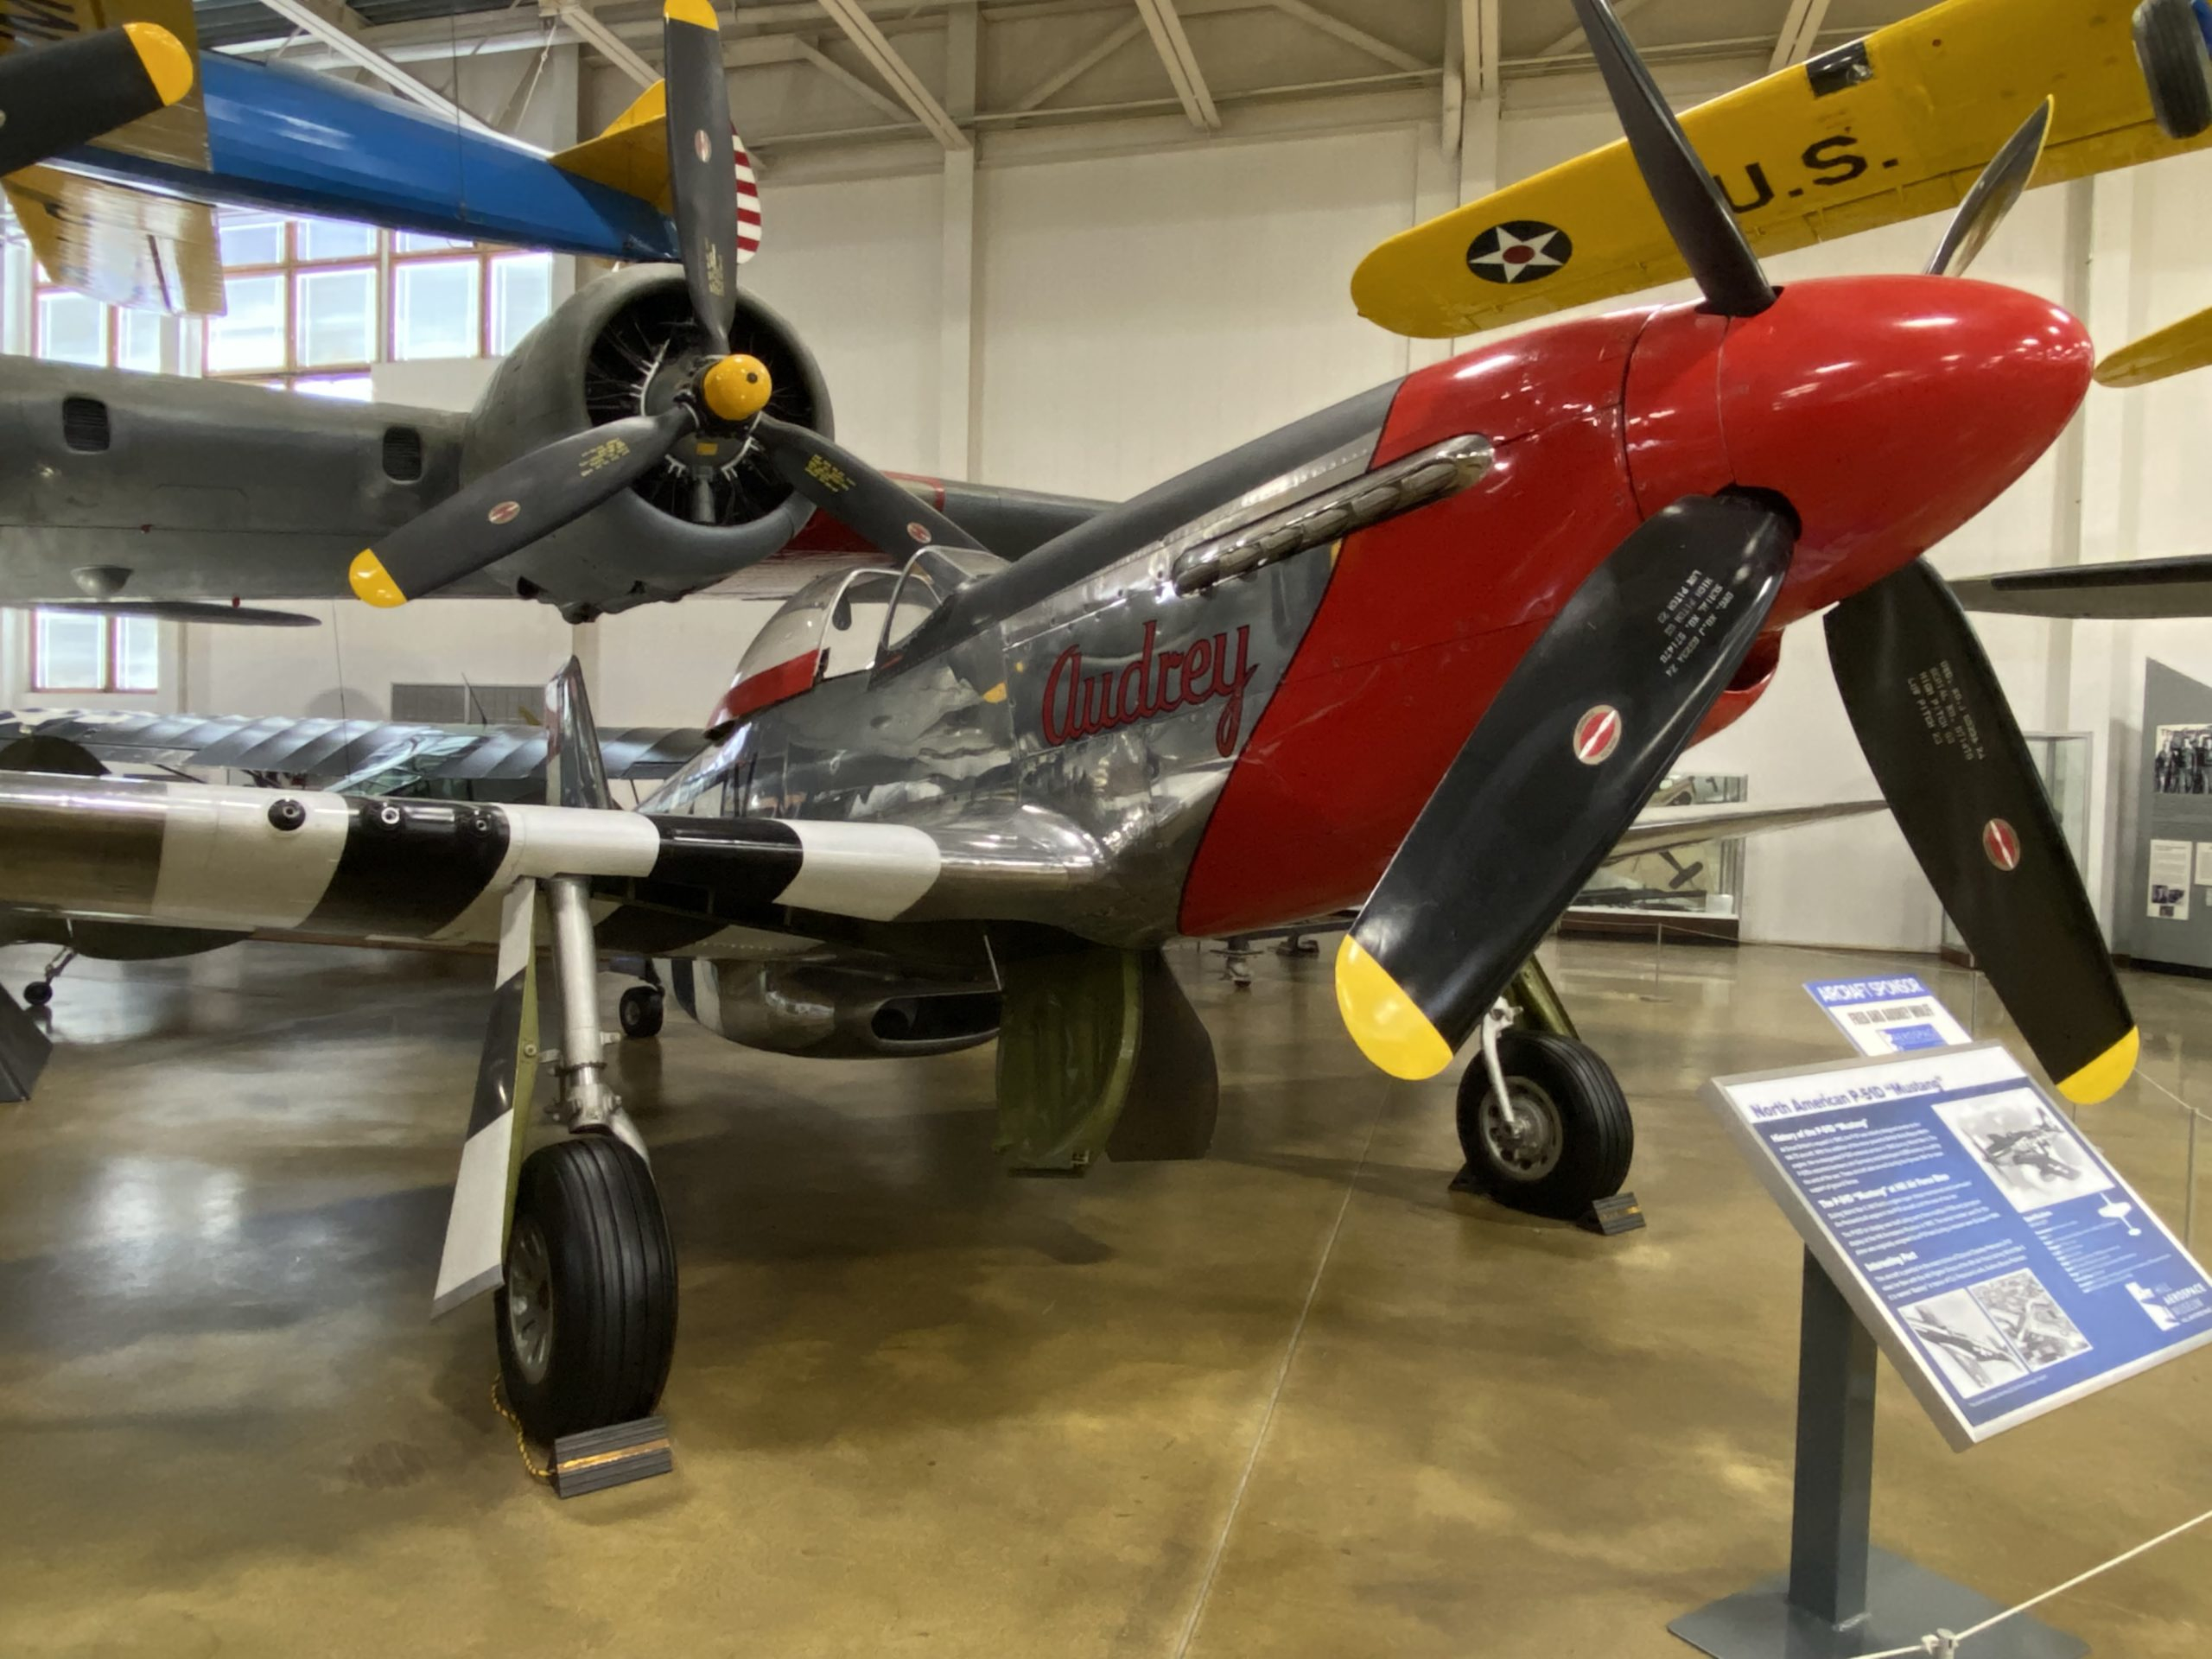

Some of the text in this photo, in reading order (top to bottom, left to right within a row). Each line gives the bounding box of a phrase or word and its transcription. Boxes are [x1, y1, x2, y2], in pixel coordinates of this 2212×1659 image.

[1713, 135, 1899, 213] U.S.
[1667, 586, 1689, 611] PITCH
[1694, 577, 1713, 598] HIGH
[1697, 583, 1724, 611] SERIAL
[1674, 598, 1697, 624] PITCH
[1042, 620, 1260, 758] Audrey
[1919, 671, 1935, 696] HIGH
[1930, 697, 1948, 728] PITCH
[1916, 698, 1936, 728] PITCH
[1817, 977, 1925, 1002] AIRCRAFT SPONSOR
[1750, 1102, 1790, 1118] North
[1792, 1094, 1848, 1111] American
[1848, 1086, 1885, 1103] P-51D
[2163, 1282, 2207, 1306] AEROSPACE
